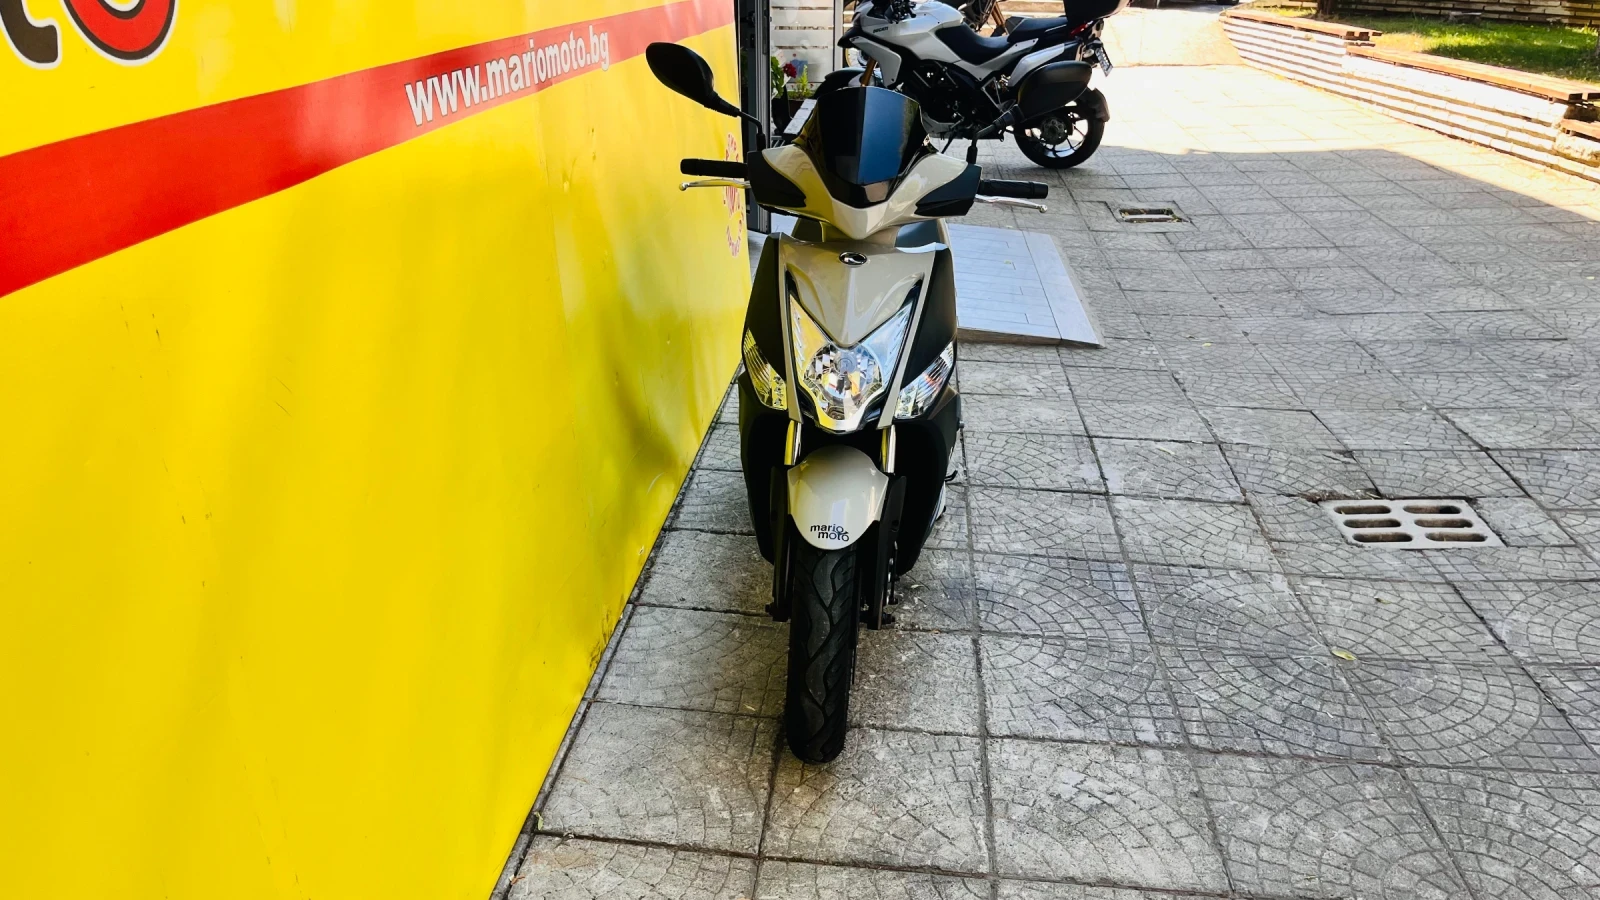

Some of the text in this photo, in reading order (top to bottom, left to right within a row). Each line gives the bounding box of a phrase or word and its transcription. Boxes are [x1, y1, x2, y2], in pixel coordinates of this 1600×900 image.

[404, 24, 610, 127] www.mariomoto.bg
[810, 524, 844, 533] mario
[817, 531, 850, 542] moto
